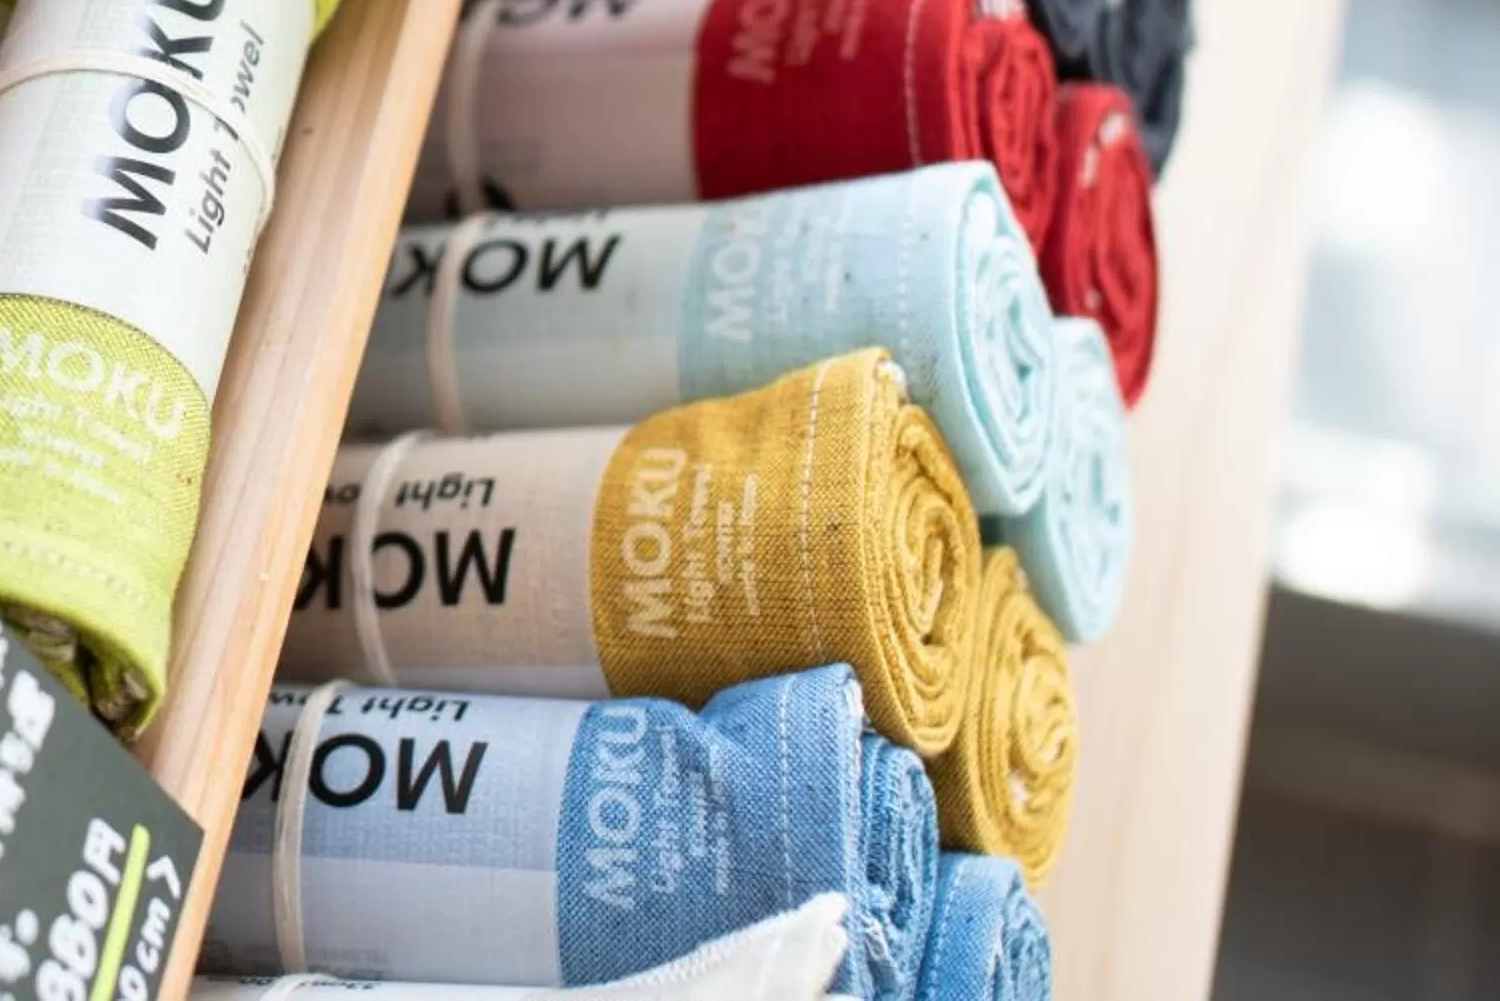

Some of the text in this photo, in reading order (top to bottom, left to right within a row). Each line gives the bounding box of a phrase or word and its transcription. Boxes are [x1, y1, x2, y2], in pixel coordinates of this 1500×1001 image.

[184, 150, 232, 255] Light
[393, 234, 622, 296] MOK
[393, 473, 497, 511] Light
[294, 528, 517, 611] MOK
[619, 447, 689, 639] MOKU
[362, 694, 472, 721] Light
[242, 729, 488, 815] MOK
[583, 705, 649, 910] MOKU
